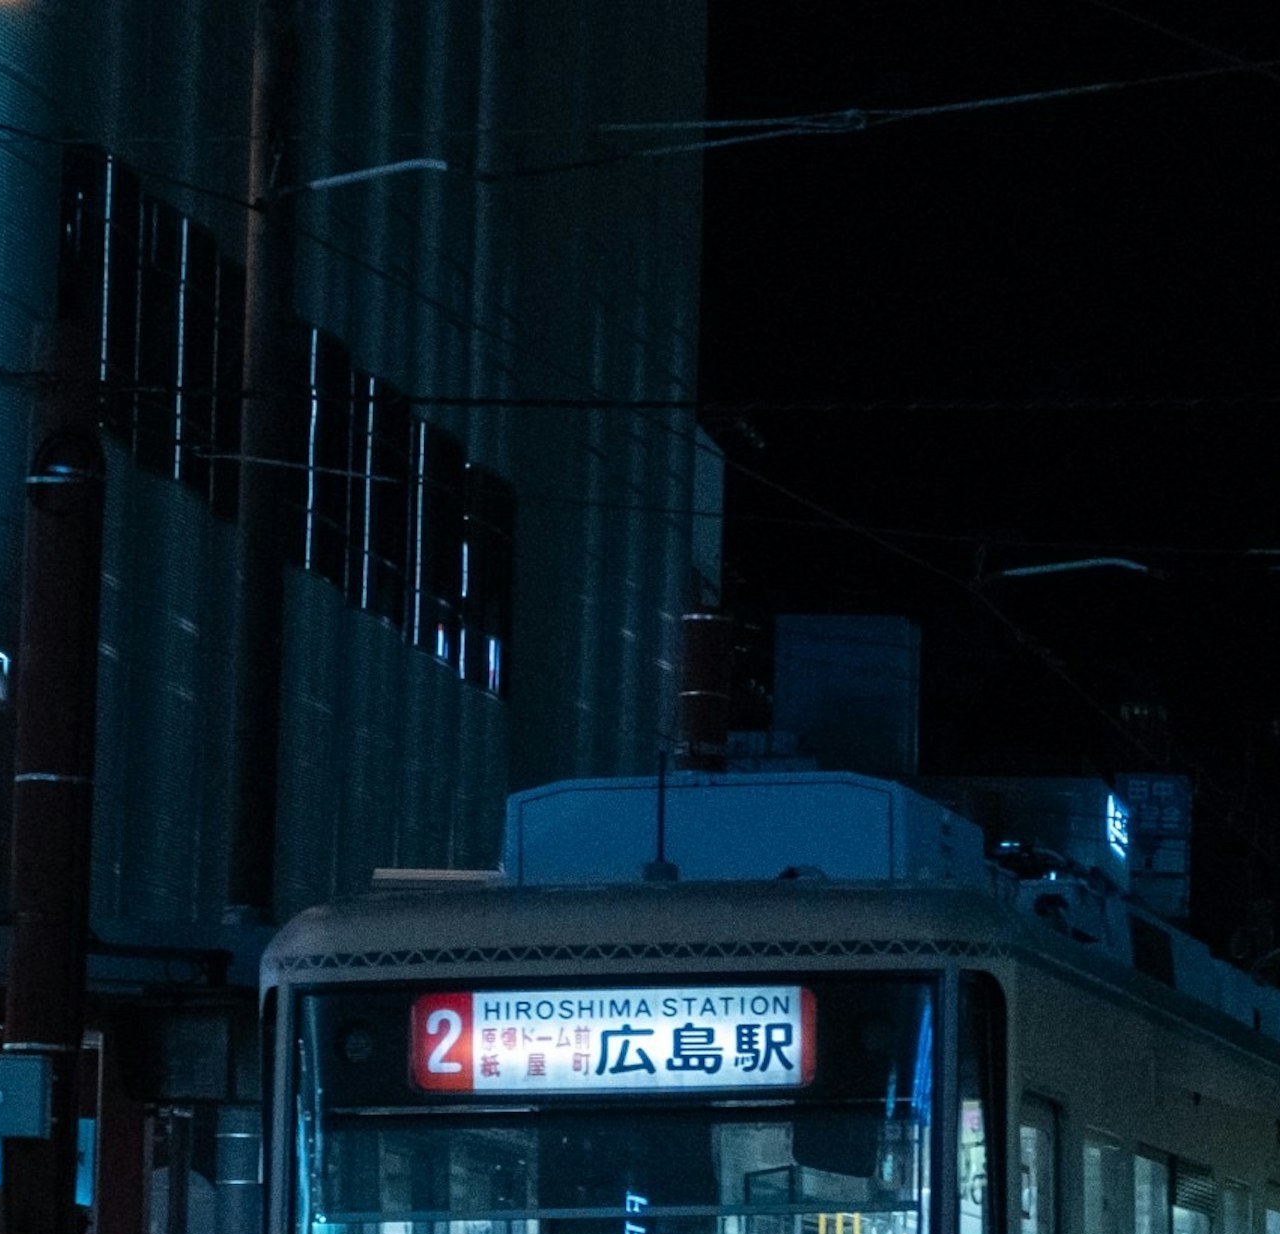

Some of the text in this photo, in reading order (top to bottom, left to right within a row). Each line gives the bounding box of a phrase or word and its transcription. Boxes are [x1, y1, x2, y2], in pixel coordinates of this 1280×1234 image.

[484, 998, 653, 1021] HIROSHIMA
[662, 995, 791, 1017] STATION
[425, 1009, 463, 1074] 2
[595, 1022, 795, 1076] 広島駅
